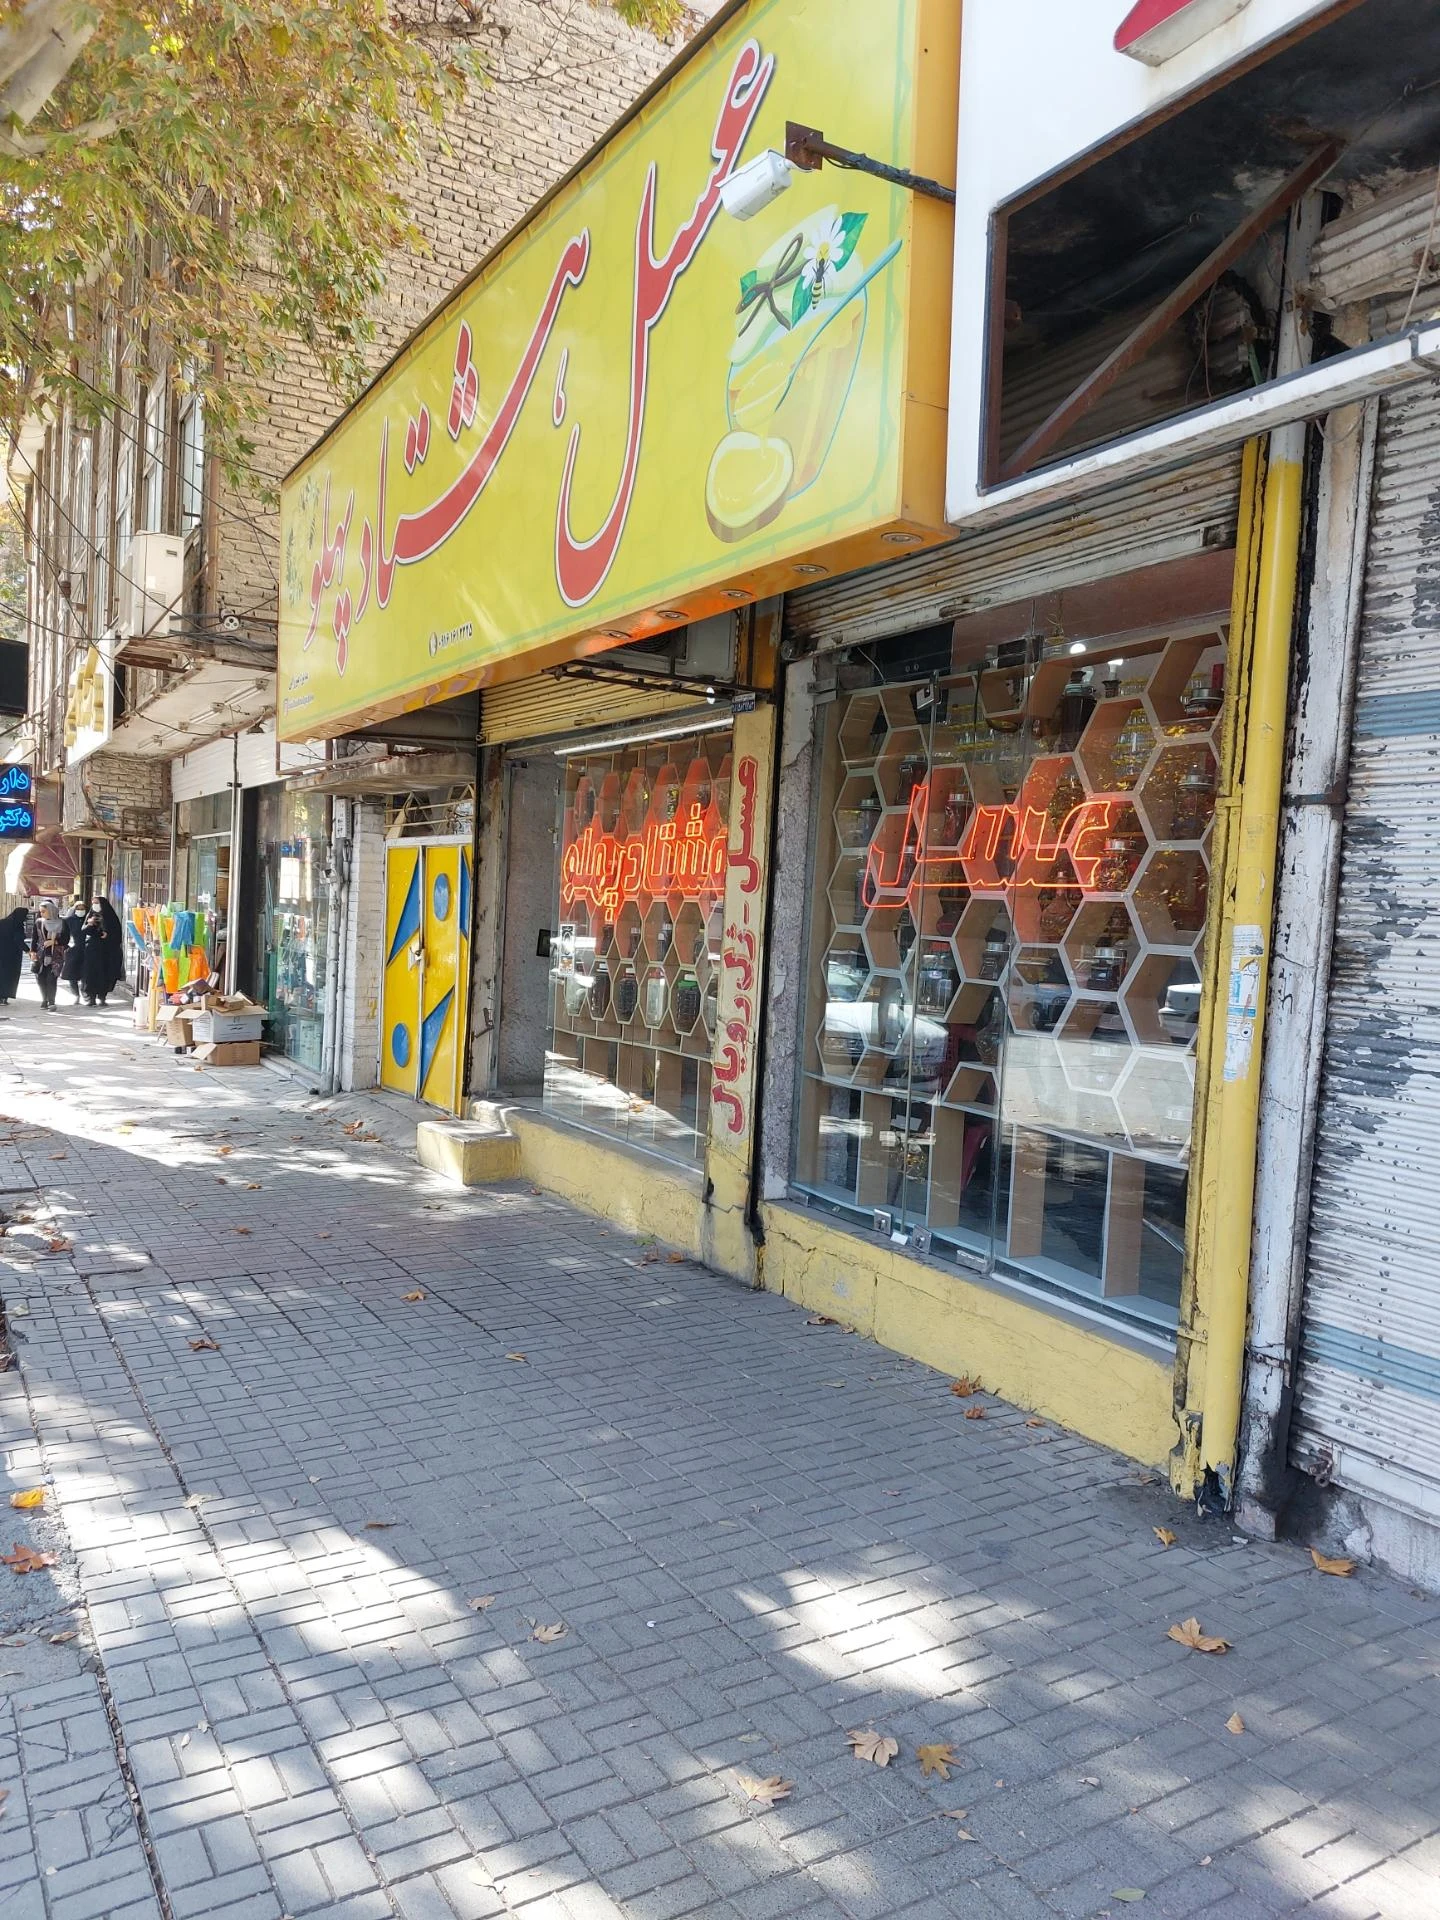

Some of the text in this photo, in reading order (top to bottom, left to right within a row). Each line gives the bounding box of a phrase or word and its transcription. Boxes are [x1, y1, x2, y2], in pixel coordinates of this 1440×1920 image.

[303, 38, 775, 678] عسل هشتاد پهلو
[727, 756, 760, 893] عسل
[862, 784, 1111, 908] عسل
[723, 923, 757, 992] ژل
[711, 994, 752, 1136] رویال
